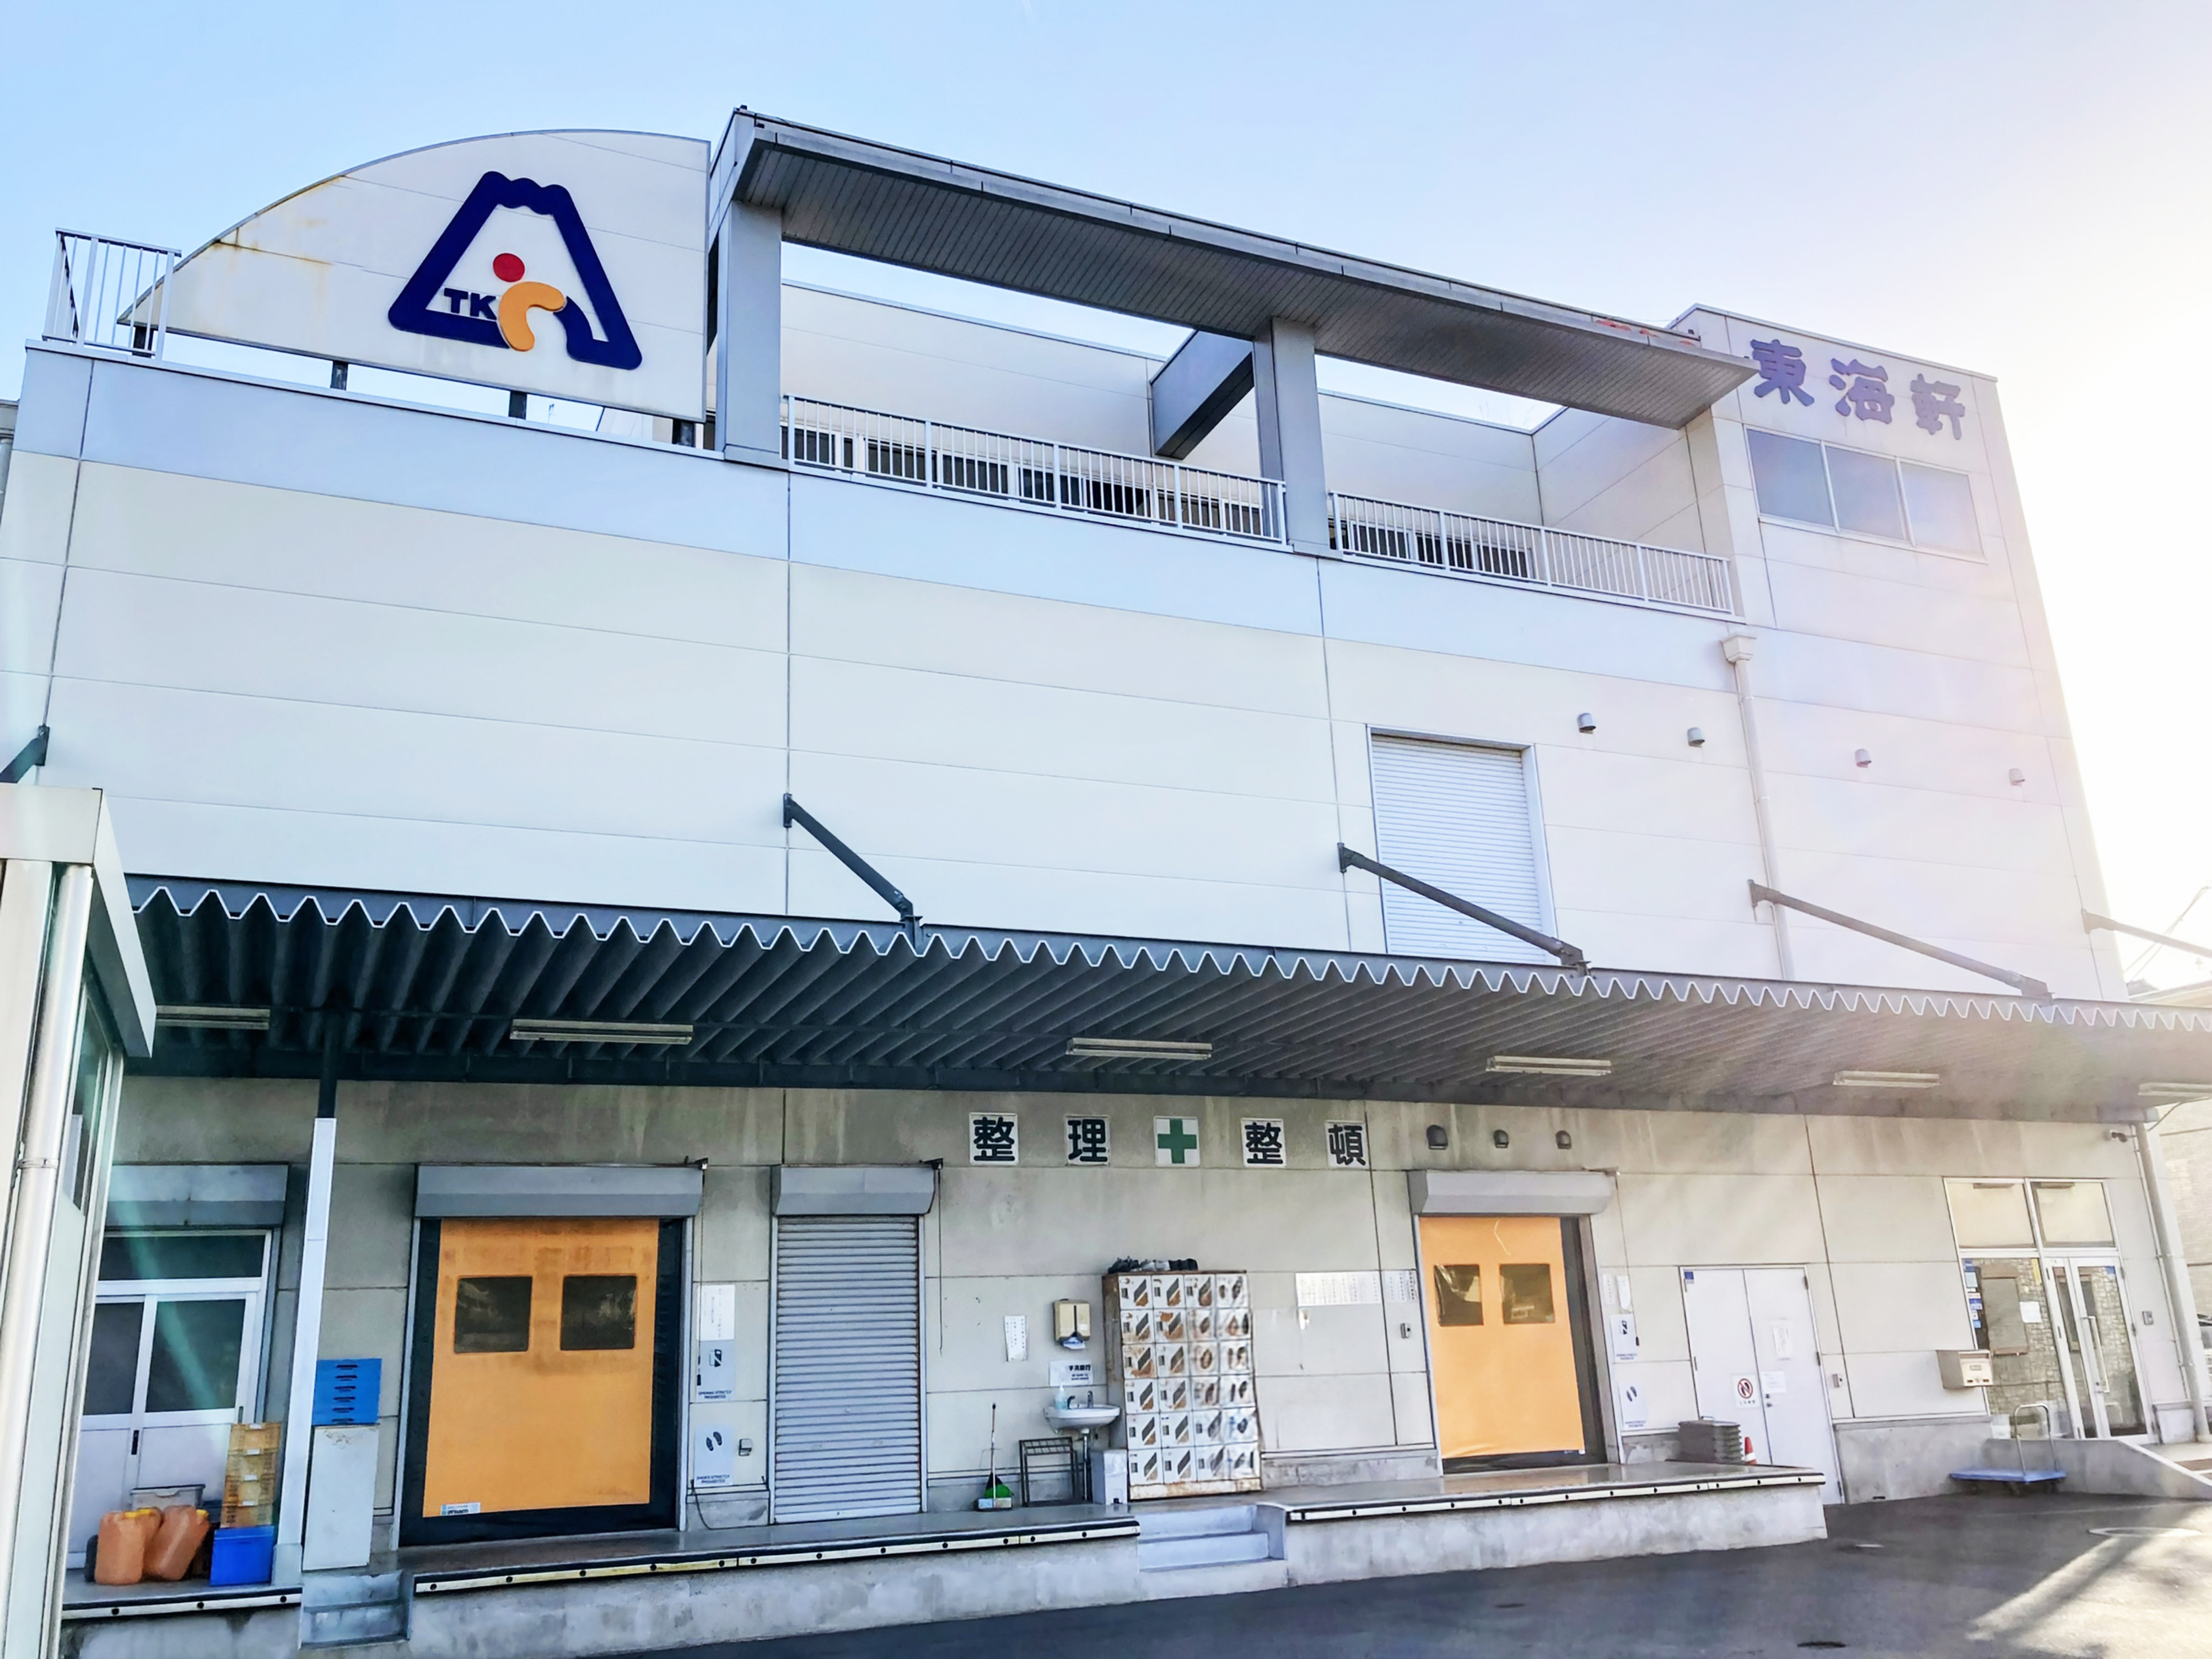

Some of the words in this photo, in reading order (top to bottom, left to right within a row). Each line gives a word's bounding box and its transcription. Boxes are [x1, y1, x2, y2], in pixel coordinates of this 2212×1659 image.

[443, 287, 497, 320] TK
[1750, 339, 1966, 440] 東海軒
